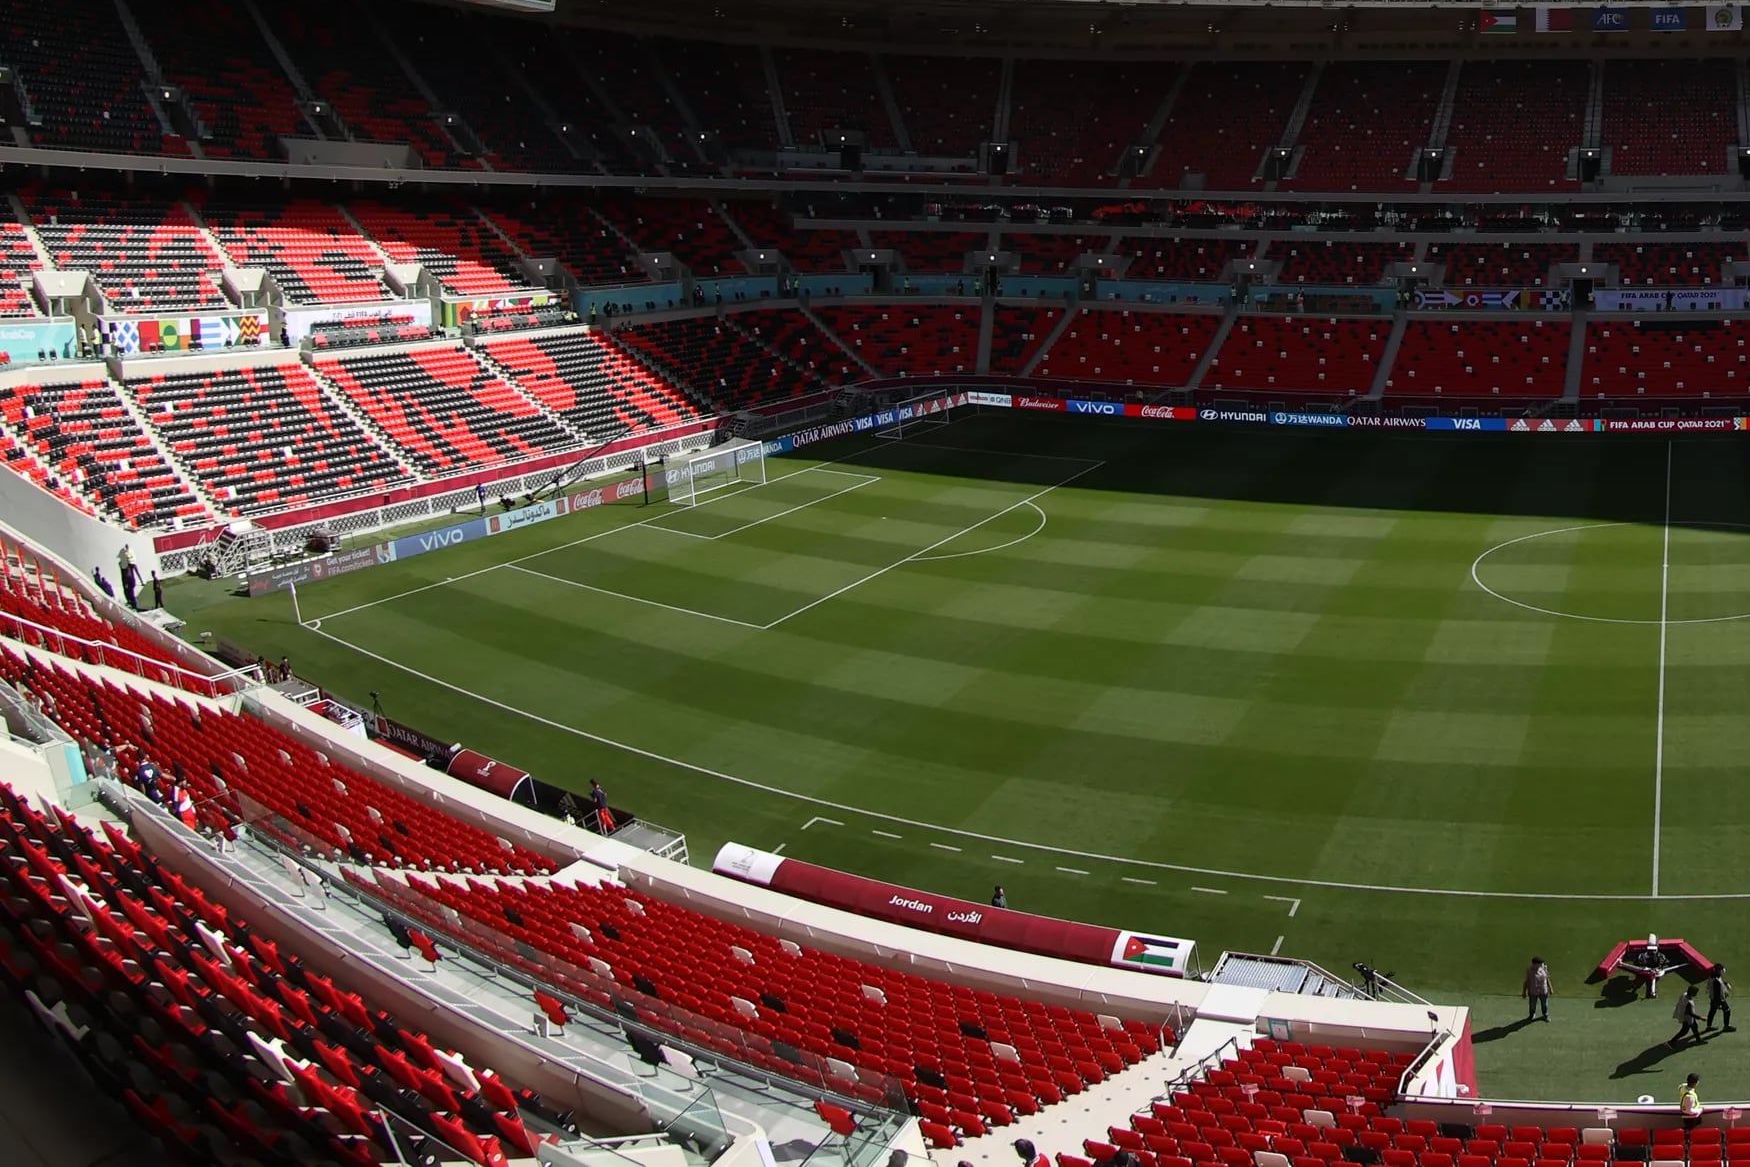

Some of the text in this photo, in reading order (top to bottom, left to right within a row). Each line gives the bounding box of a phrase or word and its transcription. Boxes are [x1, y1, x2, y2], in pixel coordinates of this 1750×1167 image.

[1597, 13, 1621, 25] AFC
[1656, 13, 1681, 24] FIFA
[1677, 292, 1699, 300] QATAR
[1018, 397, 1059, 410] Budweiser
[1076, 401, 1115, 415] vivo
[877, 412, 894, 426] VISA
[1220, 411, 1267, 422] HYUNDAI
[1347, 416, 1426, 427] QATAR AIRWAYS
[855, 416, 873, 430] VISA
[1451, 418, 1481, 429] VISA
[1610, 421, 1629, 429] FIFA
[1631, 421, 1656, 429] ARAB
[1658, 421, 1675, 429] CUP
[1677, 420, 1703, 430] QATAR
[793, 421, 854, 448] QATAR AIRWAYS
[420, 528, 463, 551] vivo
[326, 556, 338, 566] Get
[889, 895, 933, 913] Jordan
[947, 910, 983, 924] الأردن
